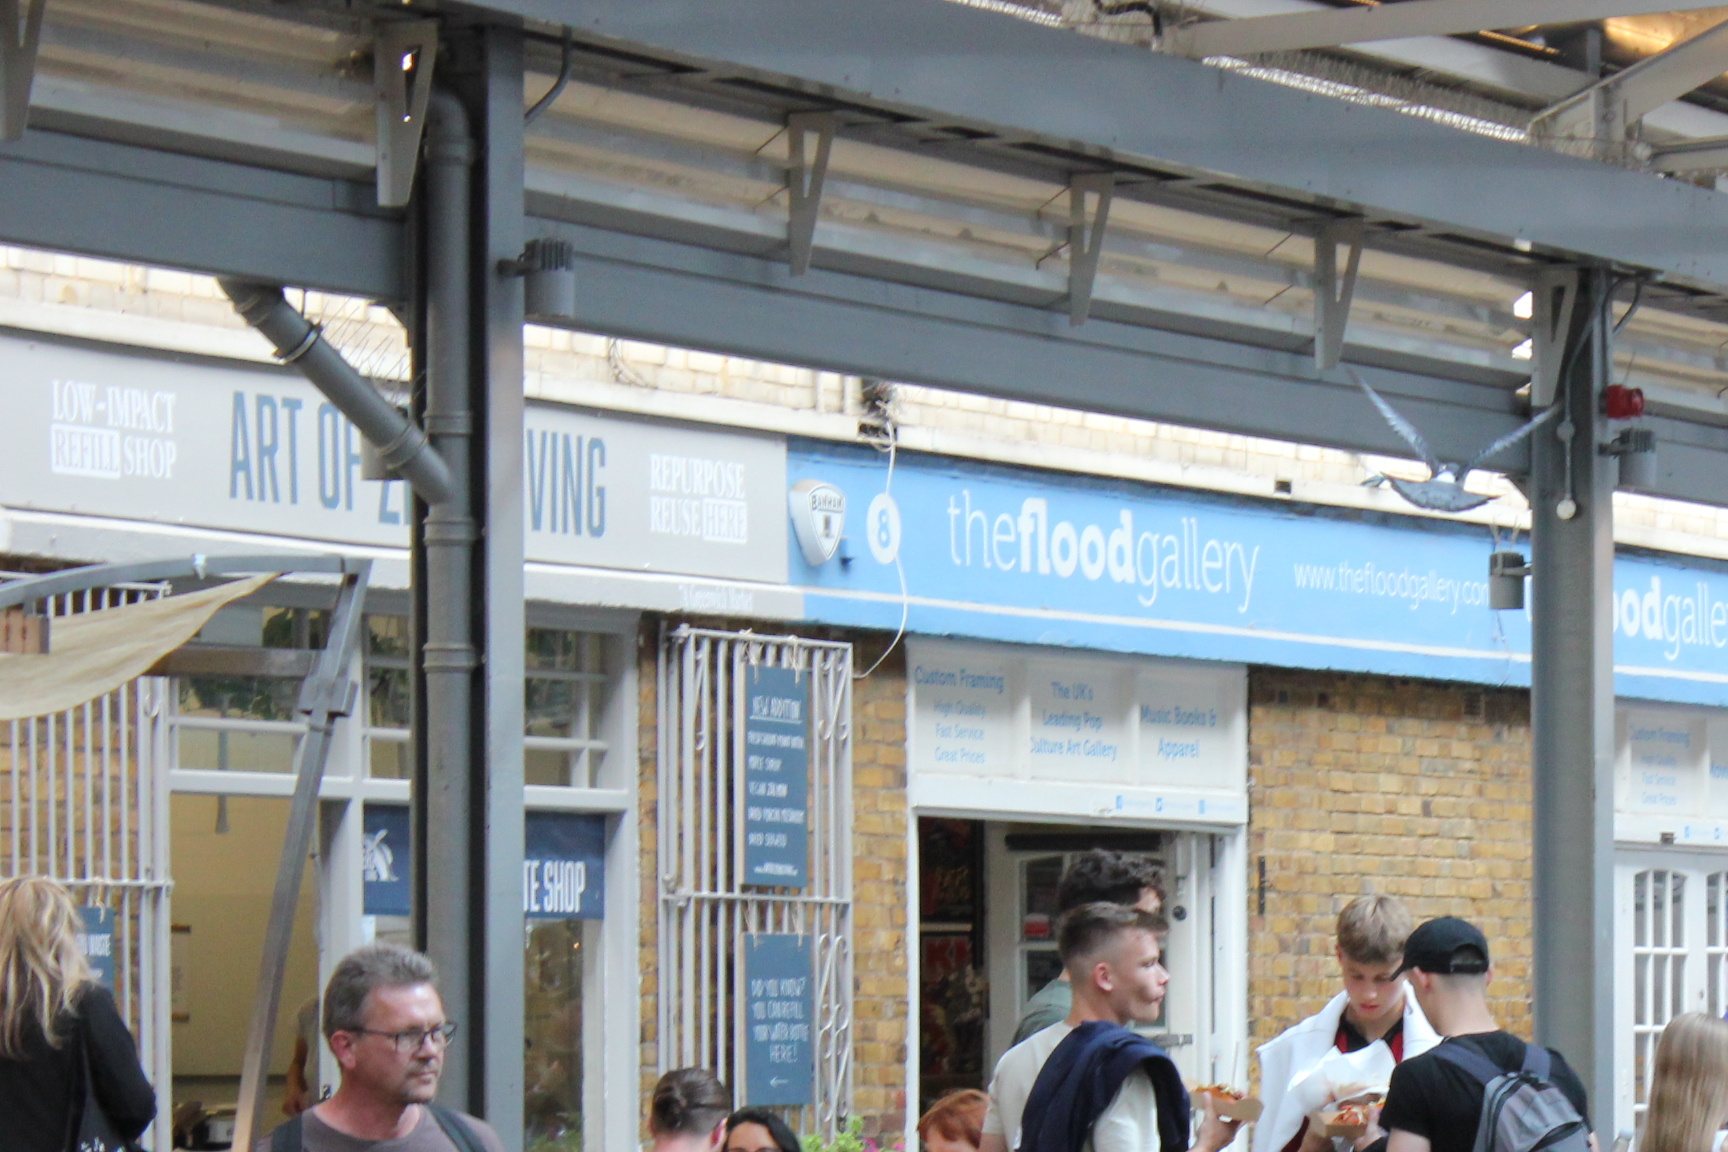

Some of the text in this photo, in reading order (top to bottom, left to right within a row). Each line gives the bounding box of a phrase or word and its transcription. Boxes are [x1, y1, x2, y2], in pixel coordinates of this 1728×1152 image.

[52, 379, 176, 434] LOW-IMPACT
[53, 430, 177, 479] REFILL SHOP
[229, 391, 303, 505] ART
[526, 430, 607, 538] VING
[650, 454, 746, 498] REPURPOSE
[650, 497, 747, 541] REUSE HERE
[878, 508, 891, 549] 8
[947, 489, 1260, 613] thefloodgallery
[543, 860, 586, 913] SHOP
